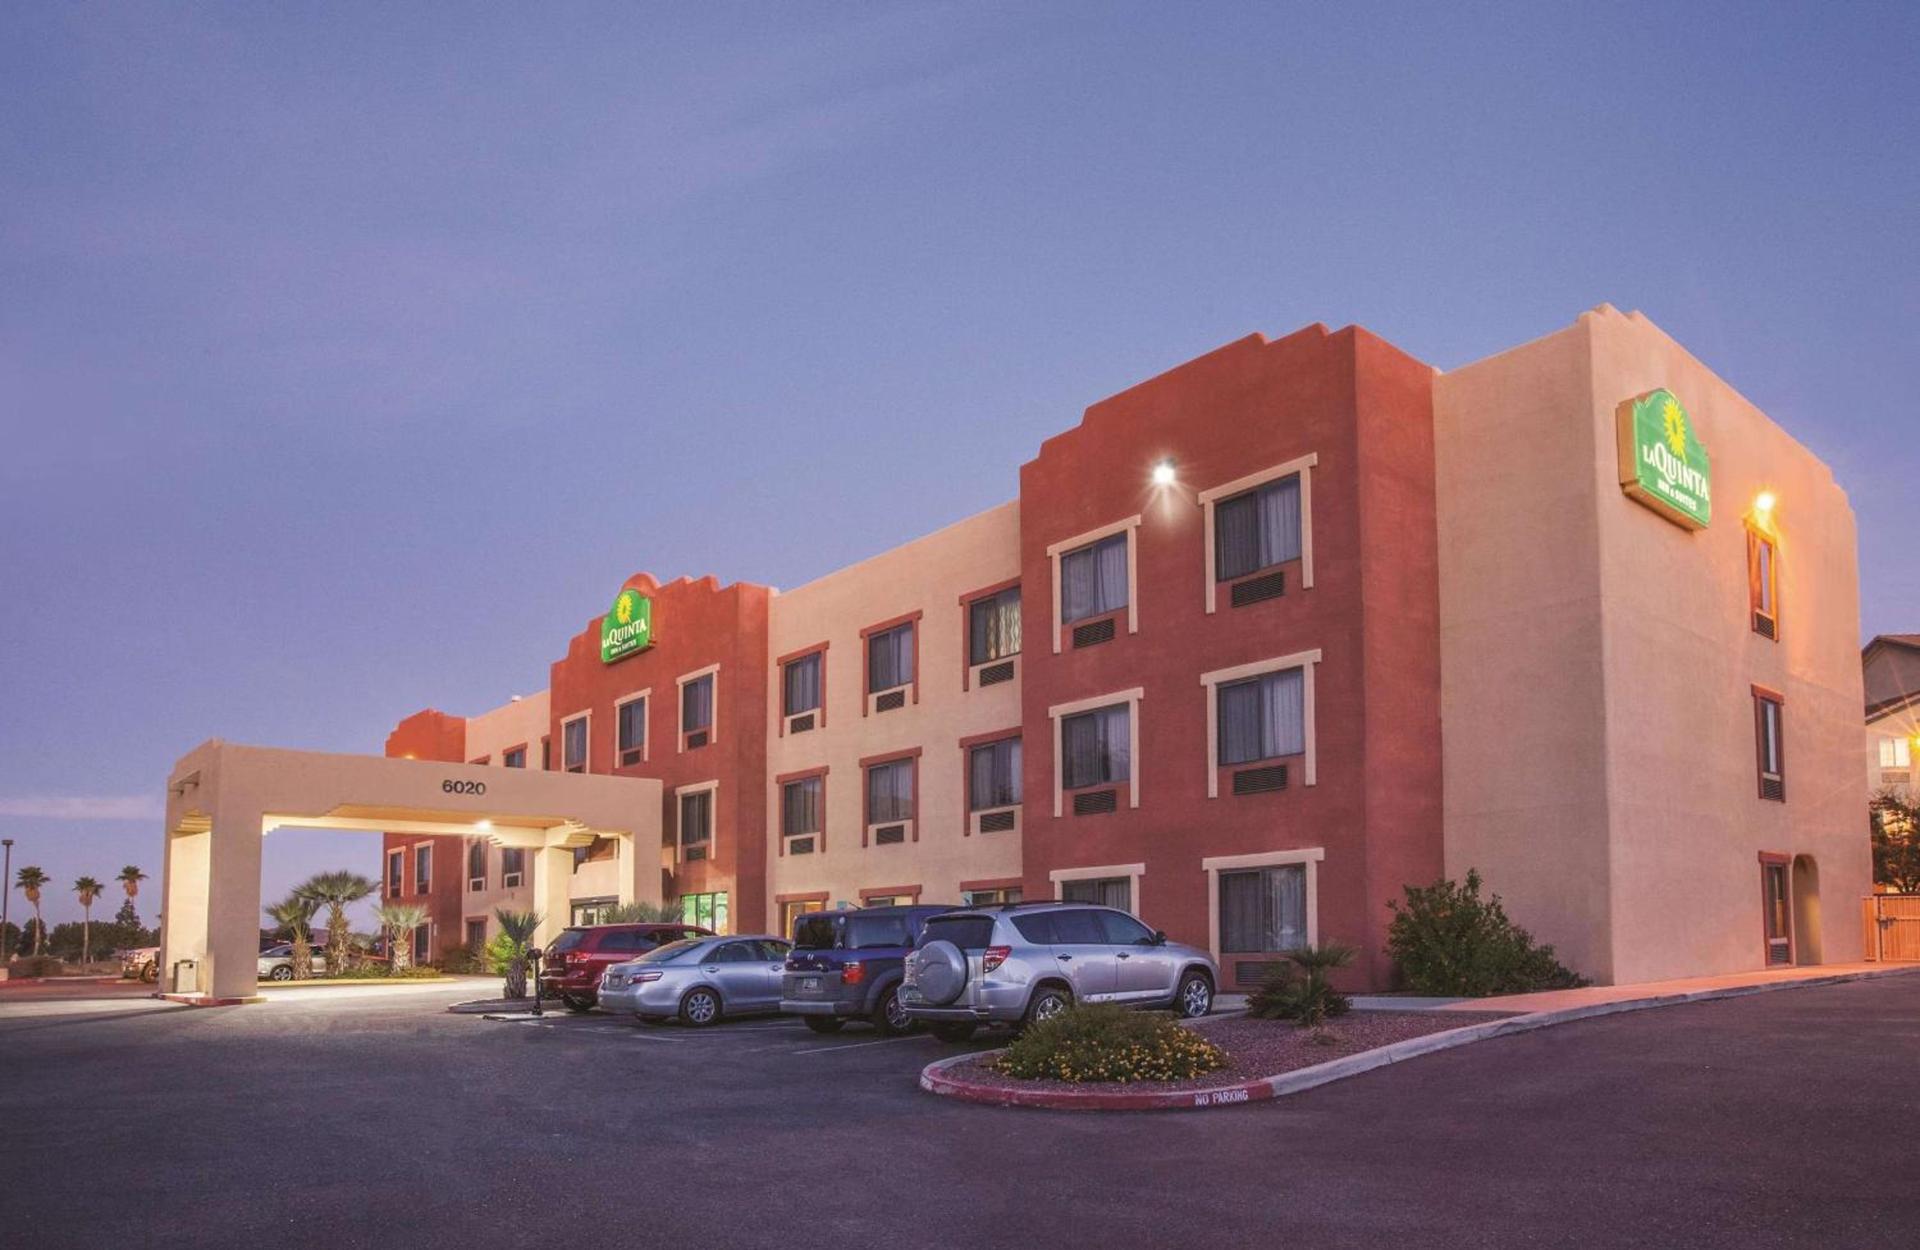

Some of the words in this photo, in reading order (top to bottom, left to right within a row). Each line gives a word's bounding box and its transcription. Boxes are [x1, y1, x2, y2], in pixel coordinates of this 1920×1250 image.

[1643, 445, 1655, 467] LA
[1654, 442, 1709, 501] QUINTA
[609, 618, 647, 645] QUINTA
[442, 779, 486, 795] 6020
[1194, 1094, 1209, 1106] NO
[1212, 1089, 1249, 1105] PARKING
